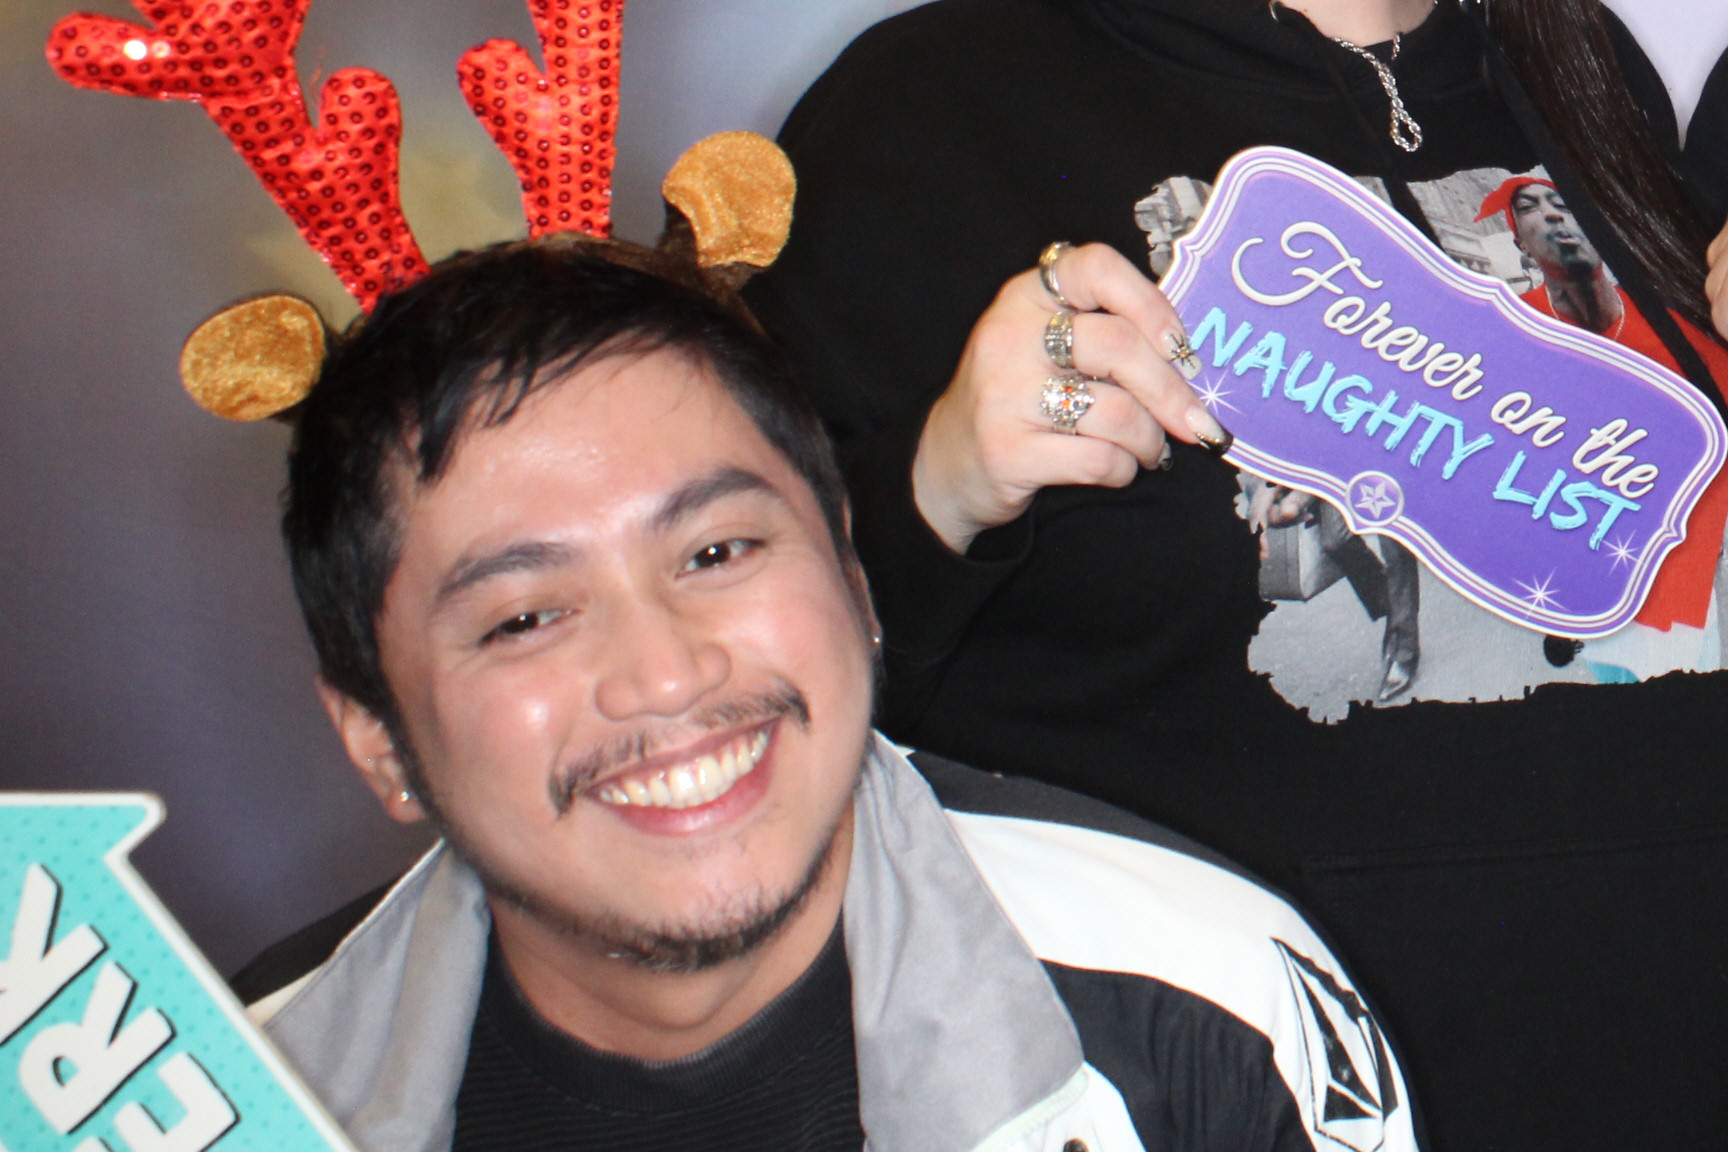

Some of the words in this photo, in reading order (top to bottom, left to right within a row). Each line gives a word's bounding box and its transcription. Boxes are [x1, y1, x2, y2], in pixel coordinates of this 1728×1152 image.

[1190, 306, 1495, 480] NAUGHTY
[1493, 450, 1642, 551] LIST
[1231, 221, 1485, 401] Forever
[1490, 390, 1567, 448] on
[1571, 418, 1660, 499] the
